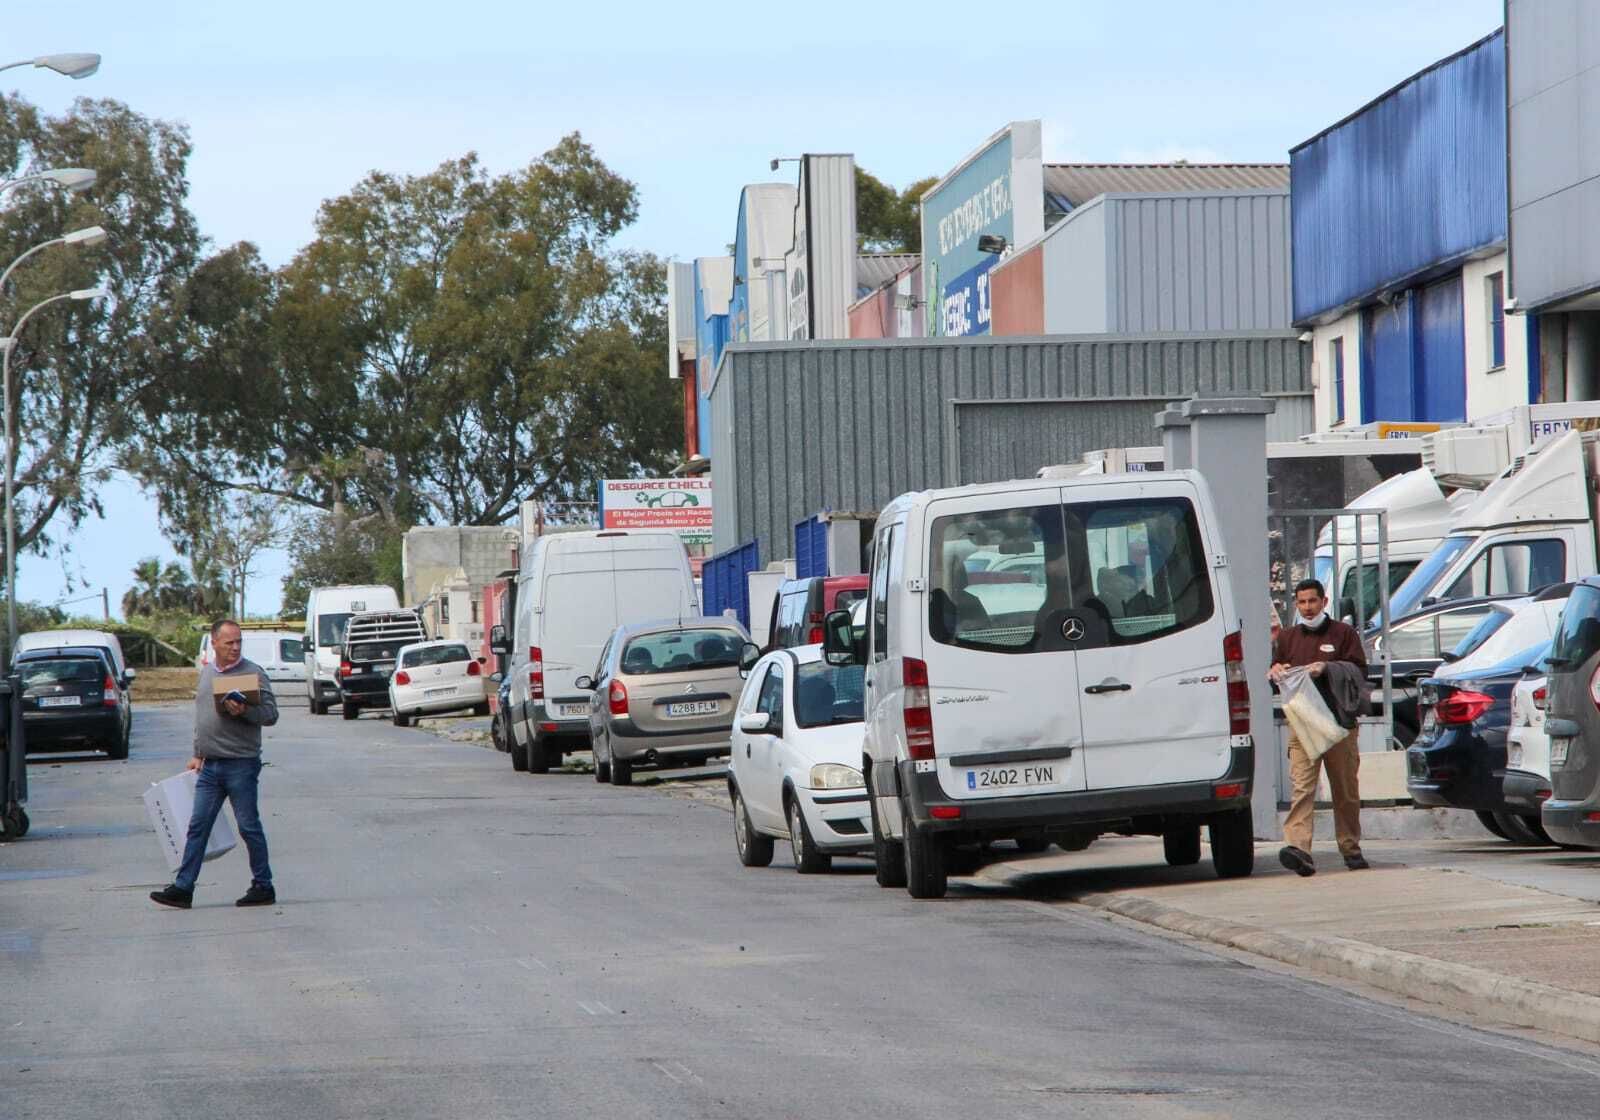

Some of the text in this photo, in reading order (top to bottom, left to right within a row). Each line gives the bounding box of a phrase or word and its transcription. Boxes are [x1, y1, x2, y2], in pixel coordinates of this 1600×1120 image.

[608, 482, 664, 491] DESGUACE
[1201, 675, 1220, 683] CDI
[980, 767, 1053, 786] 2402 FVN
